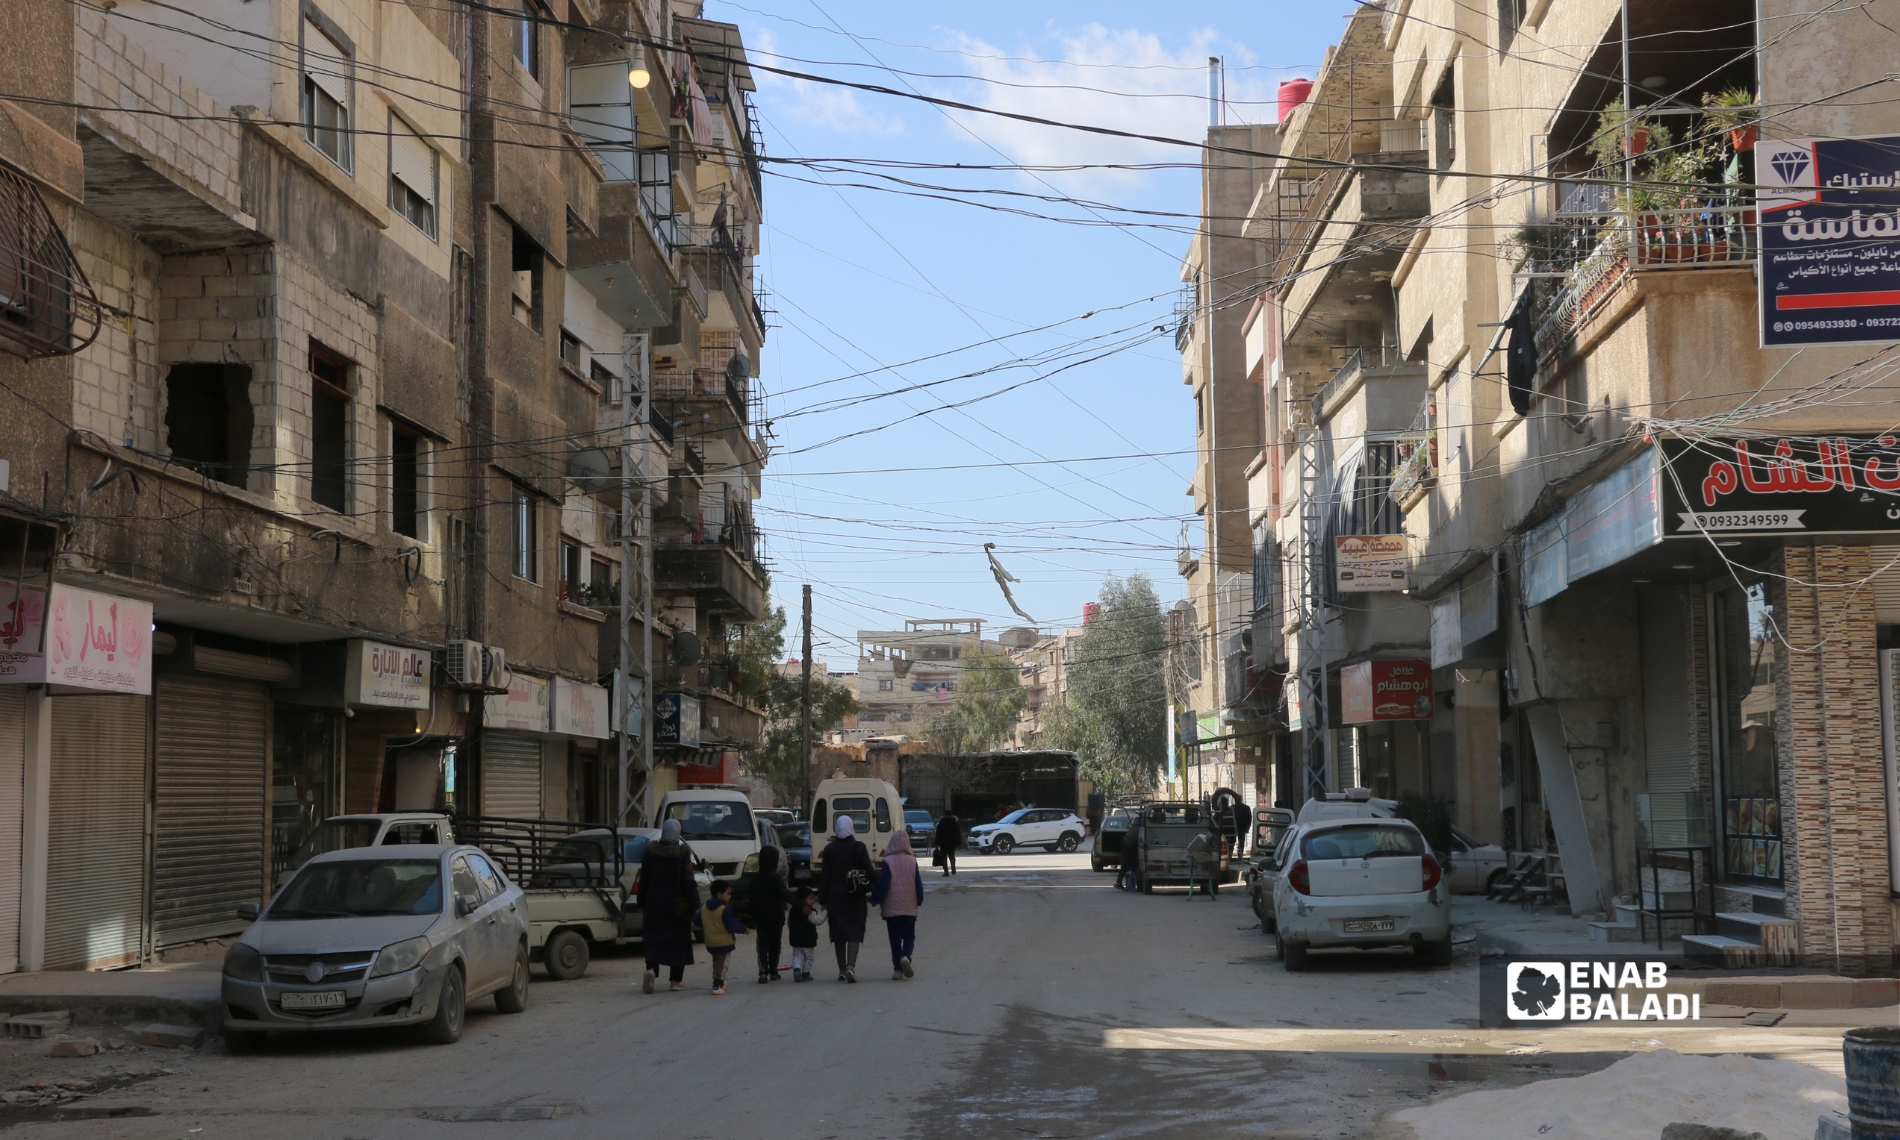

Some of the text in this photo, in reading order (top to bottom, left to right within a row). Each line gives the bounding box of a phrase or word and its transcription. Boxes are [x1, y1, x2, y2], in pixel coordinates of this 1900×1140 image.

[1860, 246, 1888, 260] نايلون
[1788, 262, 1830, 279] الأكياس
[1831, 261, 1852, 277] أنواع
[1854, 262, 1879, 276] جميع
[1795, 319, 1857, 331] 0954933930
[1702, 436, 1855, 507] الشام
[1709, 514, 1789, 527] 0932349599
[402, 652, 423, 683] عالم
[1389, 666, 1414, 677] فلافل
[1377, 677, 1429, 693] أبو هشام
